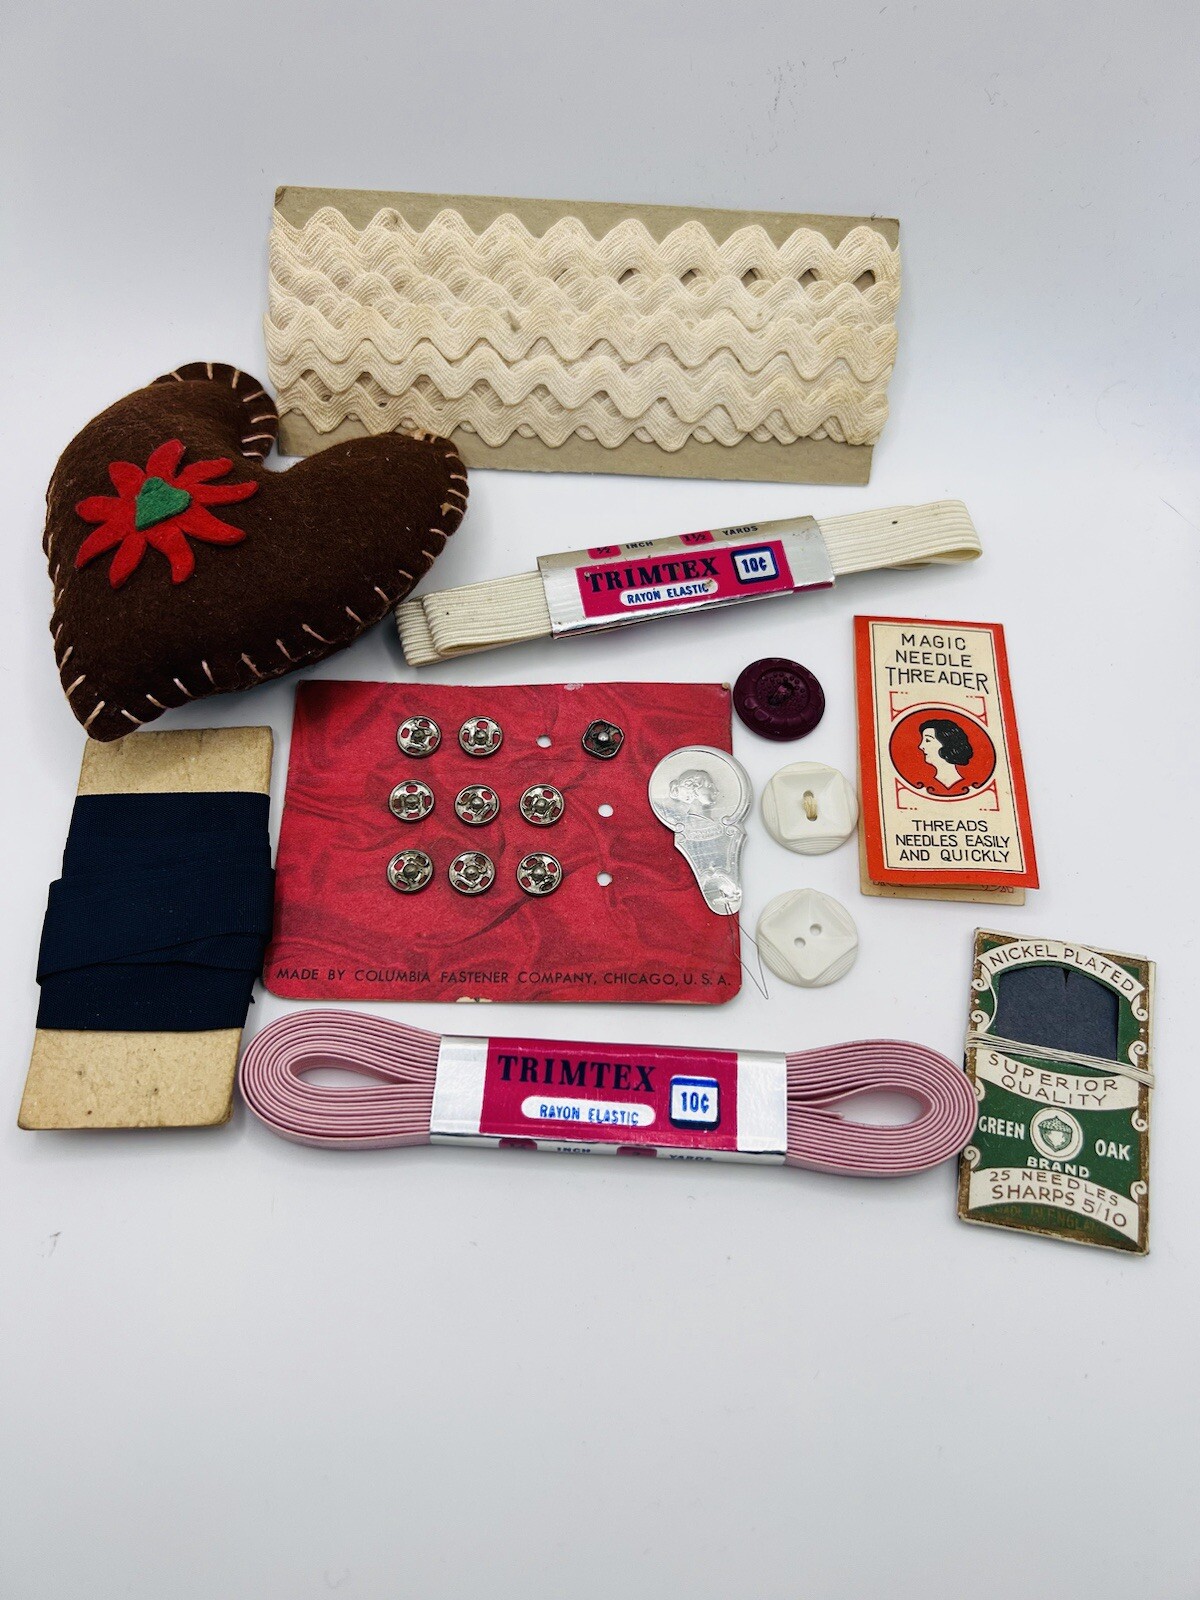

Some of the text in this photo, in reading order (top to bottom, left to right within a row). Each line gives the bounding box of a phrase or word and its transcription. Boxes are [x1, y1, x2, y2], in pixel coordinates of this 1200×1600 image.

[722, 525, 758, 536] YARDS
[625, 540, 654, 549] INCH
[585, 557, 719, 593] TRIMTEX
[741, 557, 768, 574] 10¢
[626, 582, 710, 604] RAYON ELASTIC
[901, 633, 966, 650] MAGIC
[895, 650, 972, 668] NEEDLE
[885, 666, 990, 694] THREADER
[911, 820, 988, 832] THREADS
[895, 834, 1010, 848] NEEDLES EASILY
[899, 849, 1010, 863] AND QUICKLY
[276, 968, 319, 980] MADE
[327, 969, 346, 981] BY
[354, 970, 431, 982] COLUMBIA
[440, 971, 509, 982] FASTENER
[517, 971, 598, 985] COMPANY,
[603, 972, 679, 986] CHICAGO,
[988, 944, 1135, 993] NICKEL PLATED
[497, 1055, 657, 1093] TRIMTEX
[988, 1052, 1118, 1091] SUPERIOR
[1003, 1075, 1107, 1106] QUALITY
[680, 1092, 710, 1113] 10¢
[540, 1104, 640, 1127] RAYON ELASTIC
[978, 1115, 1025, 1140] GREEN
[1095, 1139, 1131, 1161] OAK
[1027, 1156, 1091, 1179] BRAND
[990, 1170, 1119, 1206] 25 NEEDLES
[991, 1184, 1128, 1228] SHARPS 5/10
